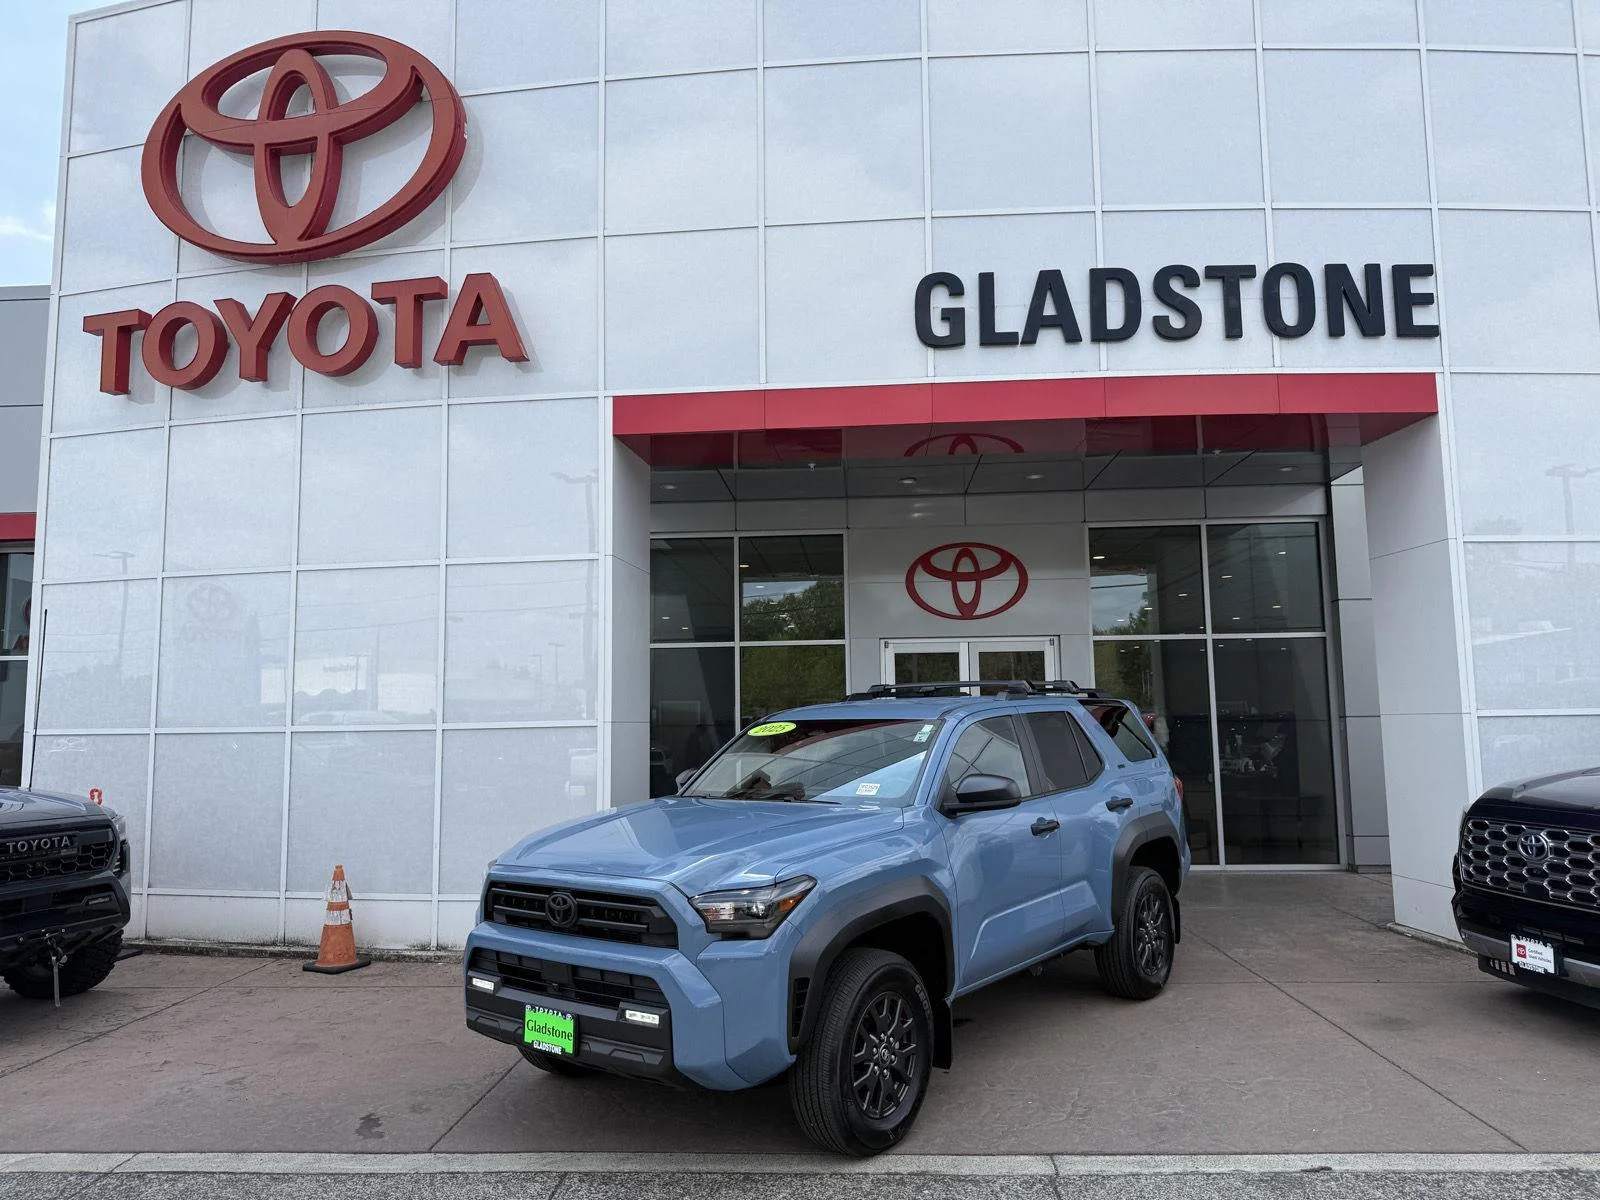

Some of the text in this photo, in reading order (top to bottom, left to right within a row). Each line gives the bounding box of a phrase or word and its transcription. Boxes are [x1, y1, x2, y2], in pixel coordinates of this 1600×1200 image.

[914, 262, 1440, 349] GLADSTONE
[83, 272, 529, 394] TOYOTA
[6, 836, 71, 854] TOYOTA
[535, 1006, 563, 1018] TOYOTA
[526, 1019, 573, 1042] Gladstone
[533, 1040, 562, 1055] GLADSTONE
